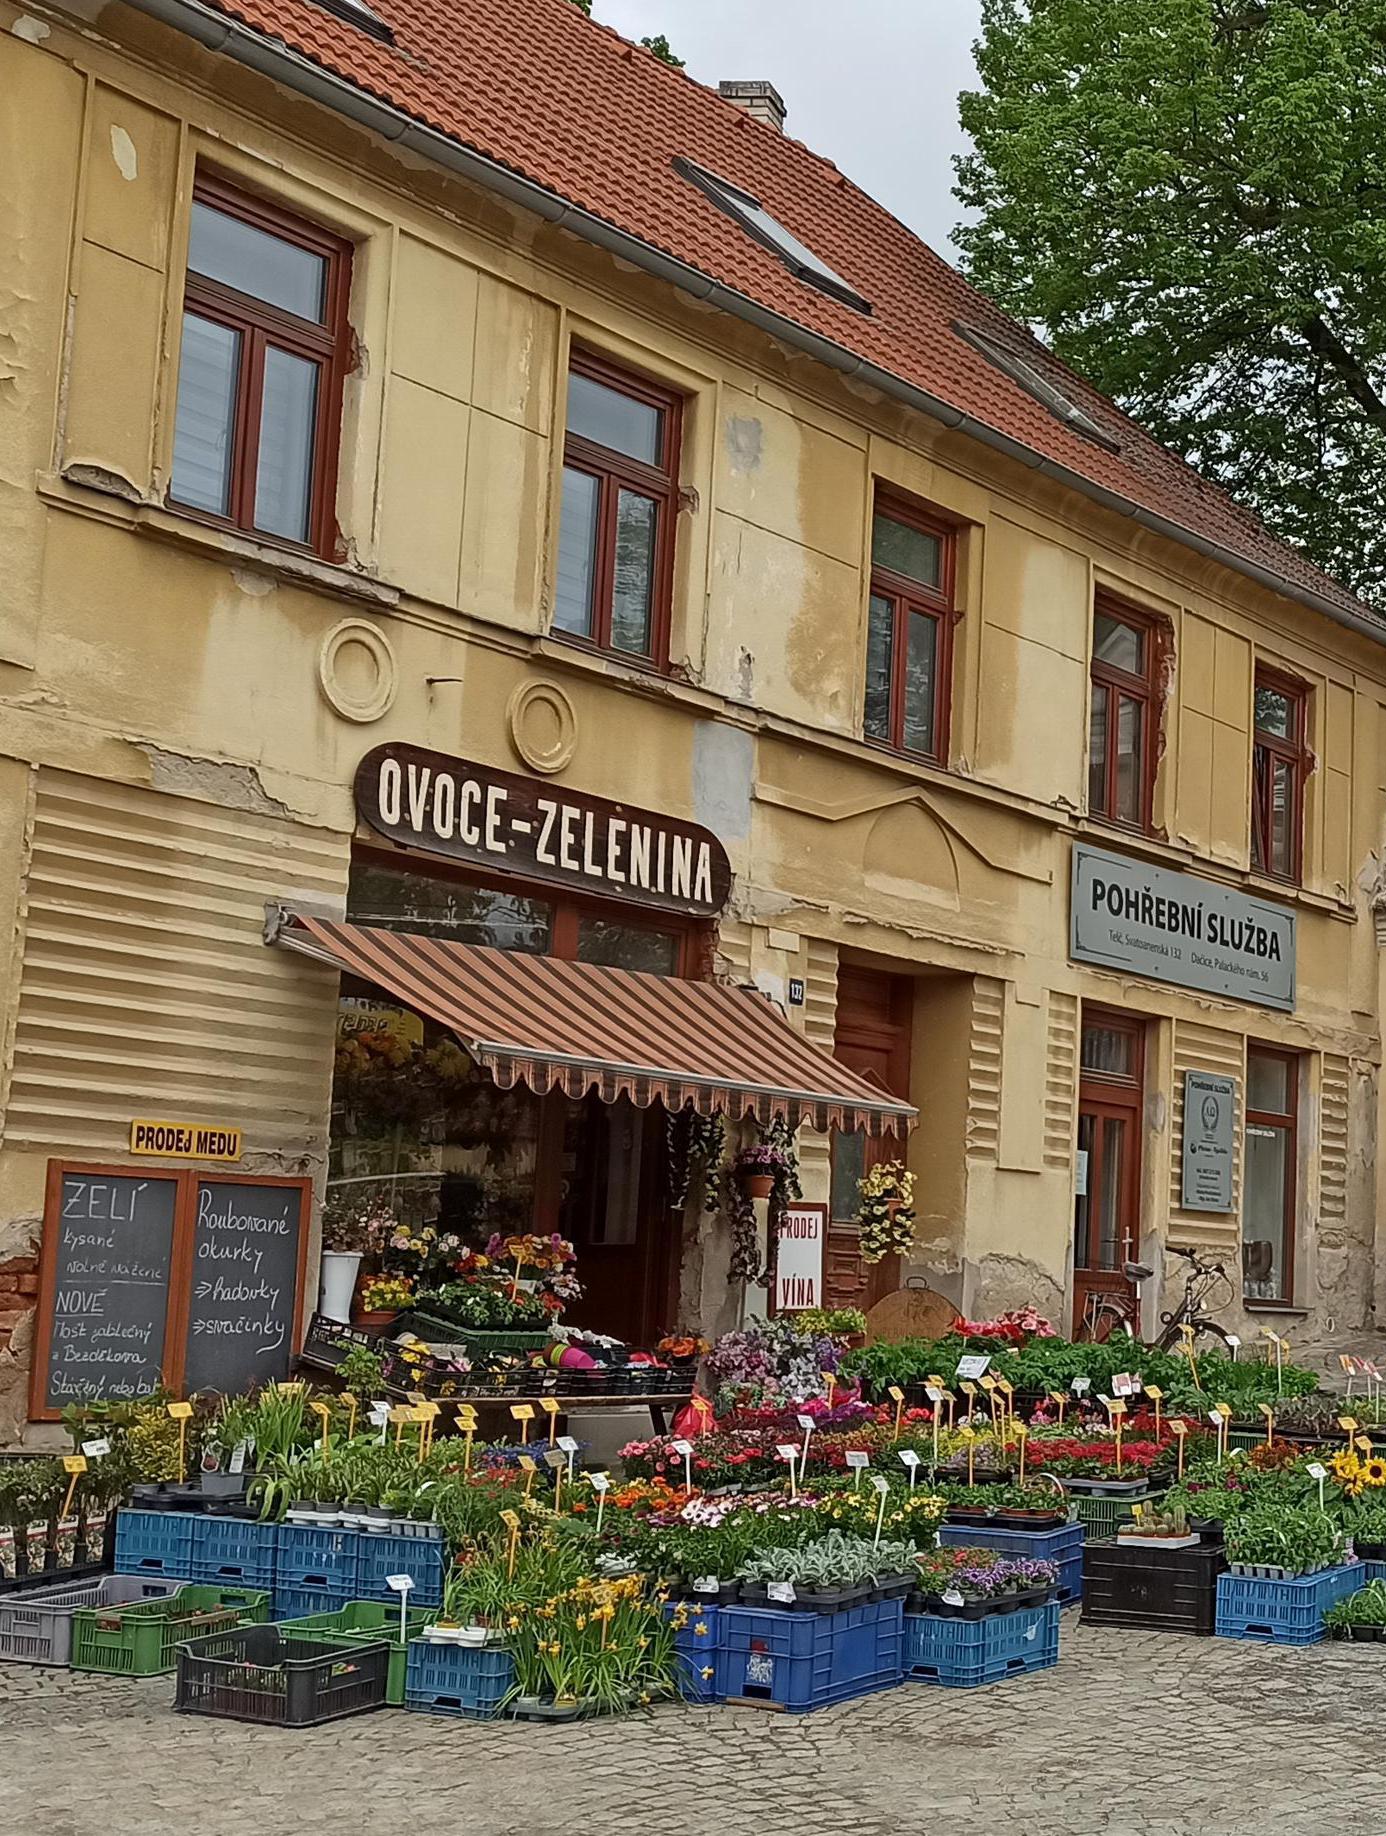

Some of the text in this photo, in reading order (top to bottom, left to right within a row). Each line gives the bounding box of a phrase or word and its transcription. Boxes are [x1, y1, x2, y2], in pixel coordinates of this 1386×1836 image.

[378, 757, 713, 904] OVOCE-ZELENINA
[1091, 878, 1282, 962] POHŘEBNÍ SLUŽBA
[136, 1125, 238, 1157] PRODEJ MEDU
[62, 1181, 149, 1222] ZELÍ
[197, 1188, 291, 1235] Roubované
[198, 1235, 264, 1275] okurky
[55, 1287, 109, 1314] NOVÉ
[782, 1272, 814, 1307] VÍNA
